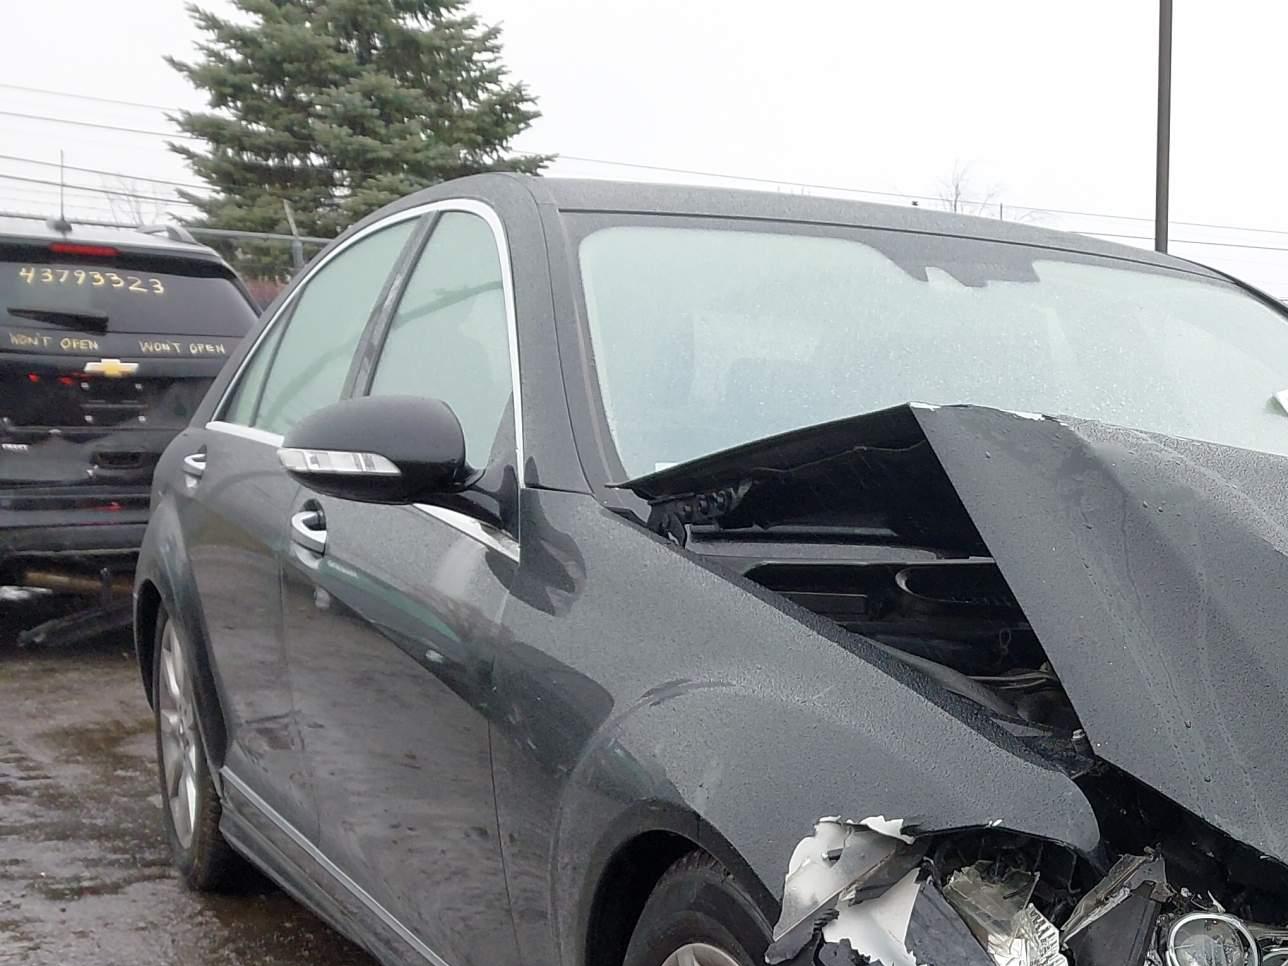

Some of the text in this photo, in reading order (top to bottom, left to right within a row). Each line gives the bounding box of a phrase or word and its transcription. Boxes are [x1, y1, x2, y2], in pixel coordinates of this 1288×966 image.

[19, 266, 165, 294] 43793323
[60, 337, 98, 350] OPEN
[189, 343, 226, 354] OPEN
